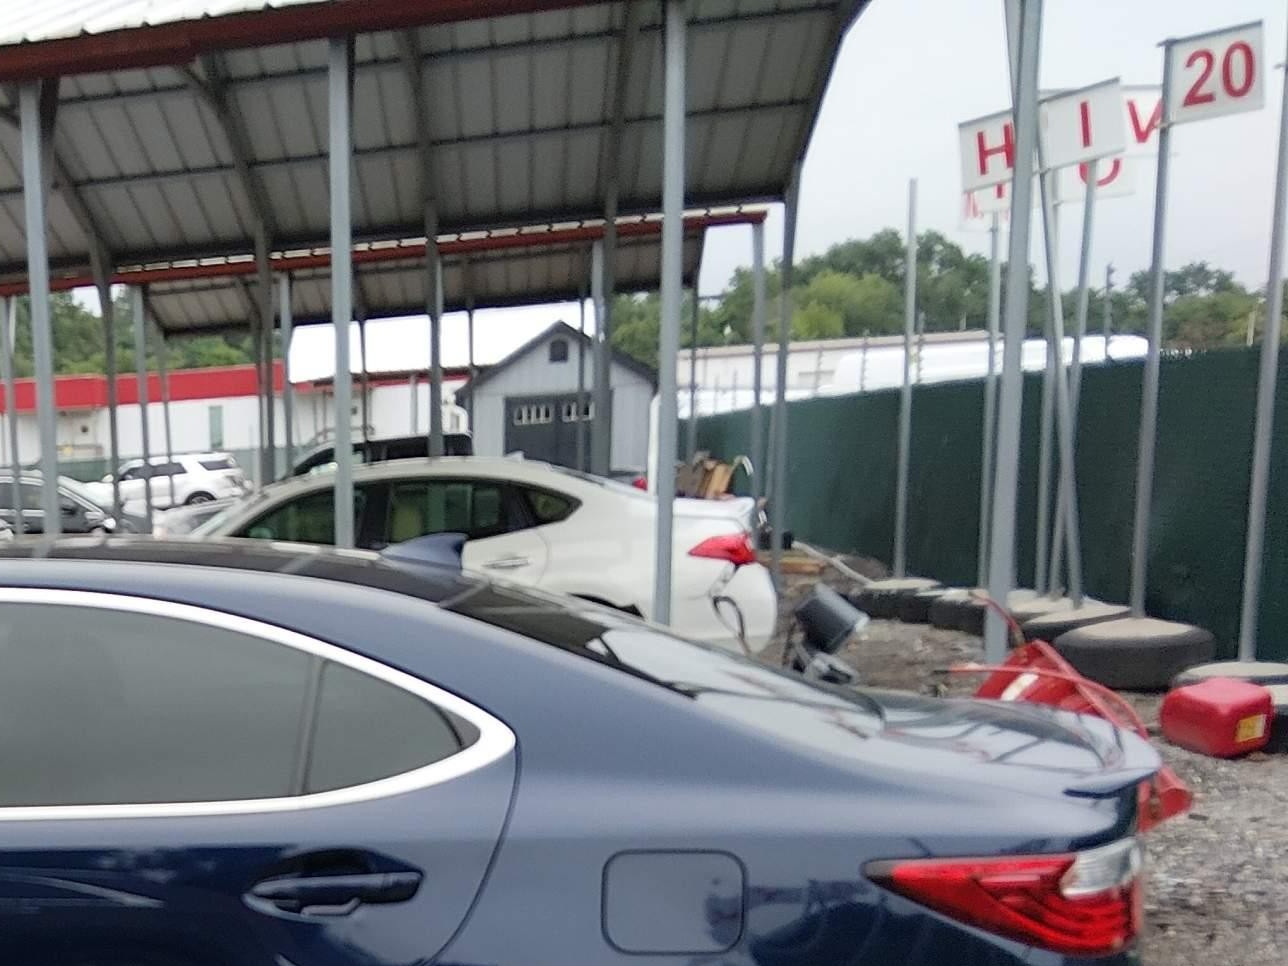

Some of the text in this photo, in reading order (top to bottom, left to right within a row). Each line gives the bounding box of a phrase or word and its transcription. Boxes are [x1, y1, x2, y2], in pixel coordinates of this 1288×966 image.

[1183, 41, 1257, 107] 20
[976, 122, 1016, 176] H
[1079, 101, 1092, 148] I
